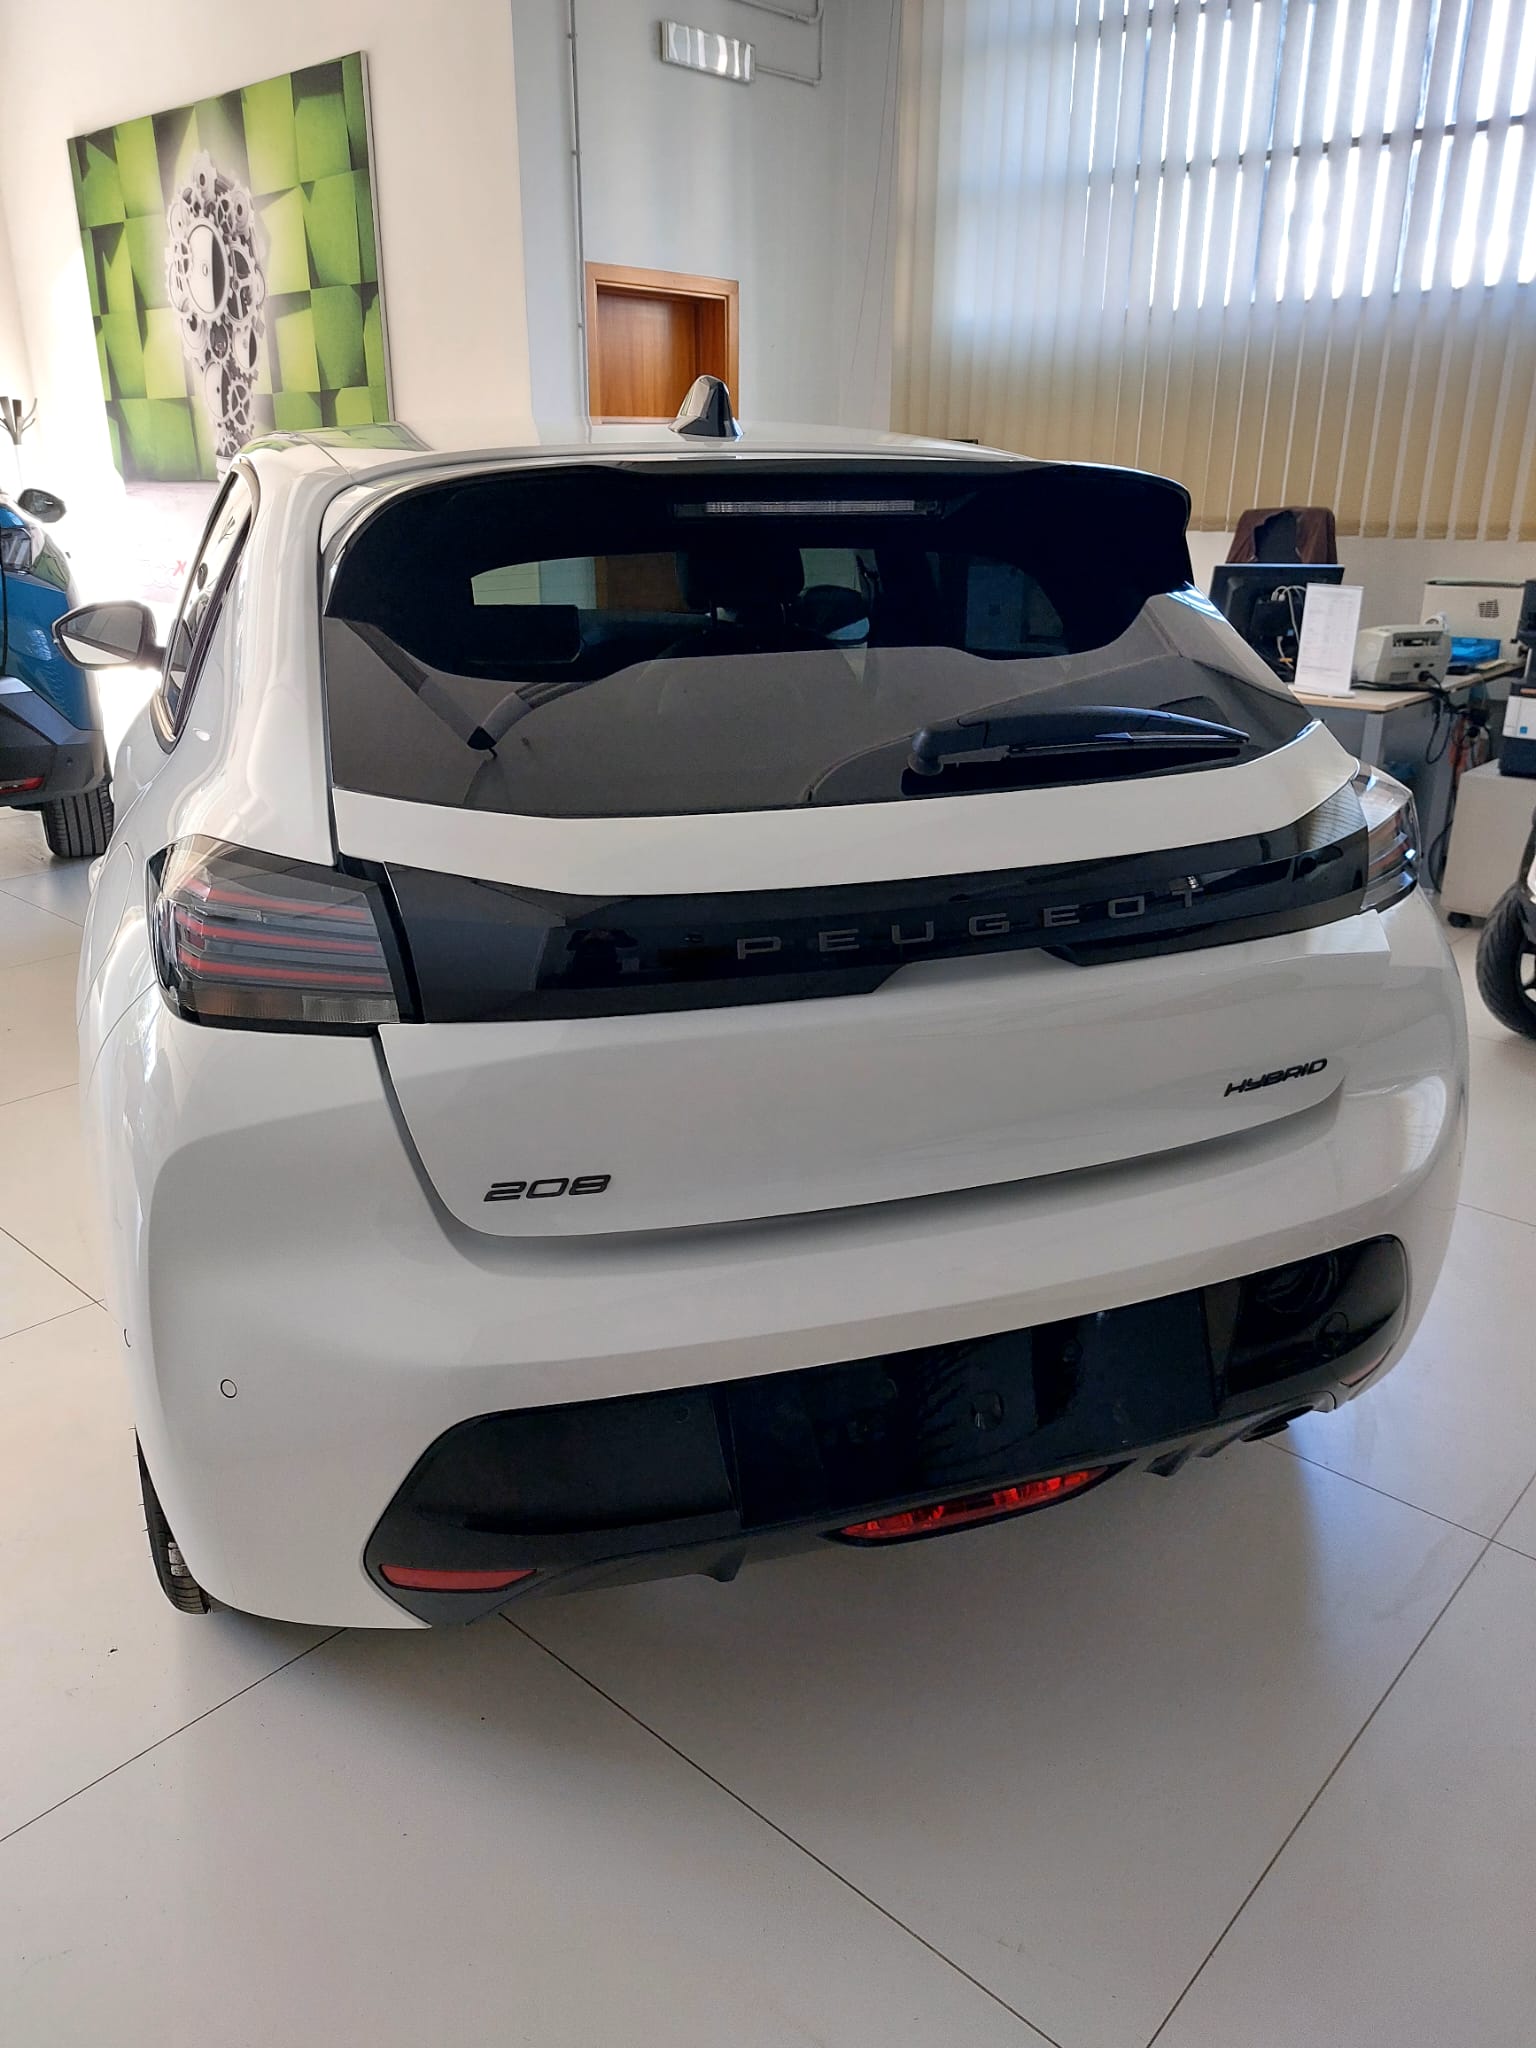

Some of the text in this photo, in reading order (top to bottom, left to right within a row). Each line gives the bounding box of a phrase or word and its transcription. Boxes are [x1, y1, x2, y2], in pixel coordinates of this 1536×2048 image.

[736, 886, 1204, 960] PEUGEOT
[1224, 1057, 1328, 1098] HYBRID
[483, 1174, 612, 1202] 208
